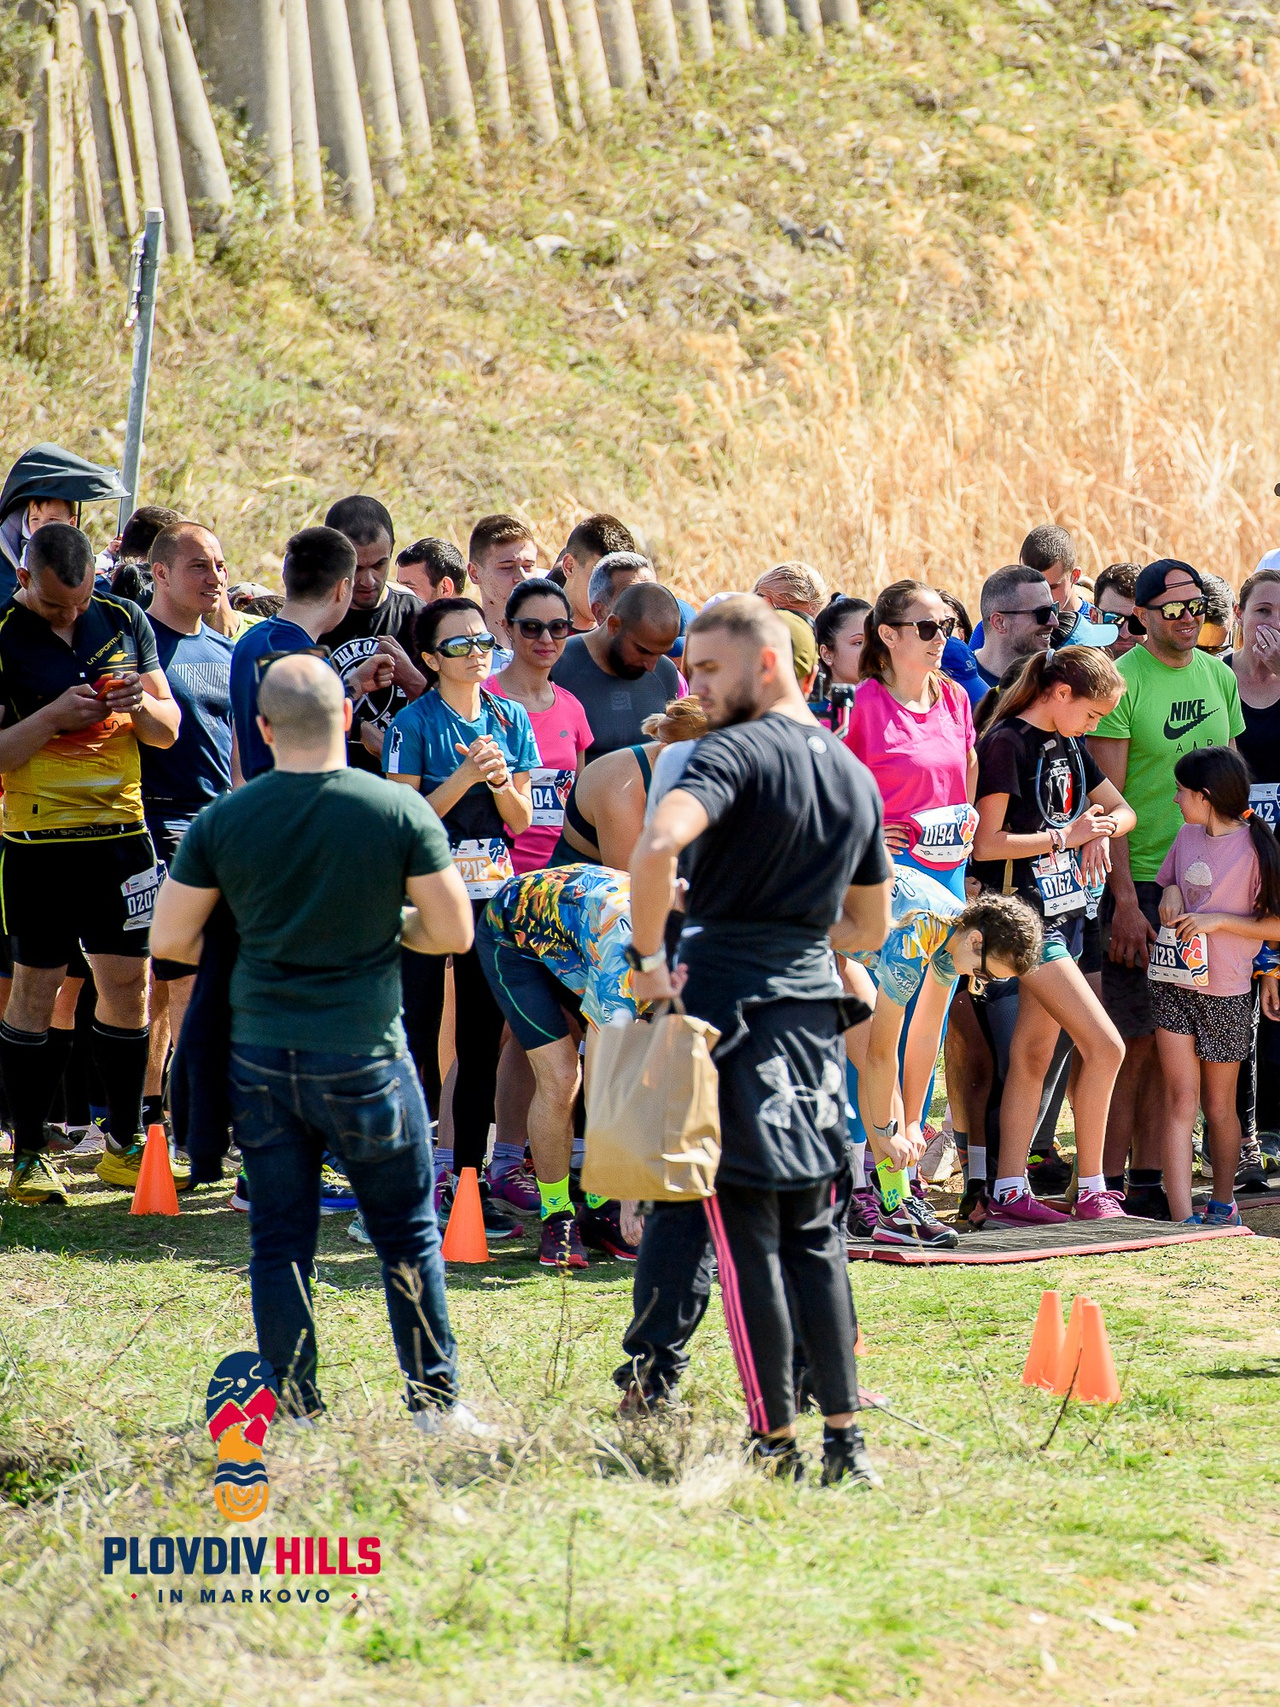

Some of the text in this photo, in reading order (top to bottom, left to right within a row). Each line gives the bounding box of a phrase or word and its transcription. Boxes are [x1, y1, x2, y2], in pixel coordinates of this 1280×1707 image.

[1169, 698, 1206, 722] NIKE
[922, 823, 956, 847] 0194
[1041, 872, 1074, 899] 0162
